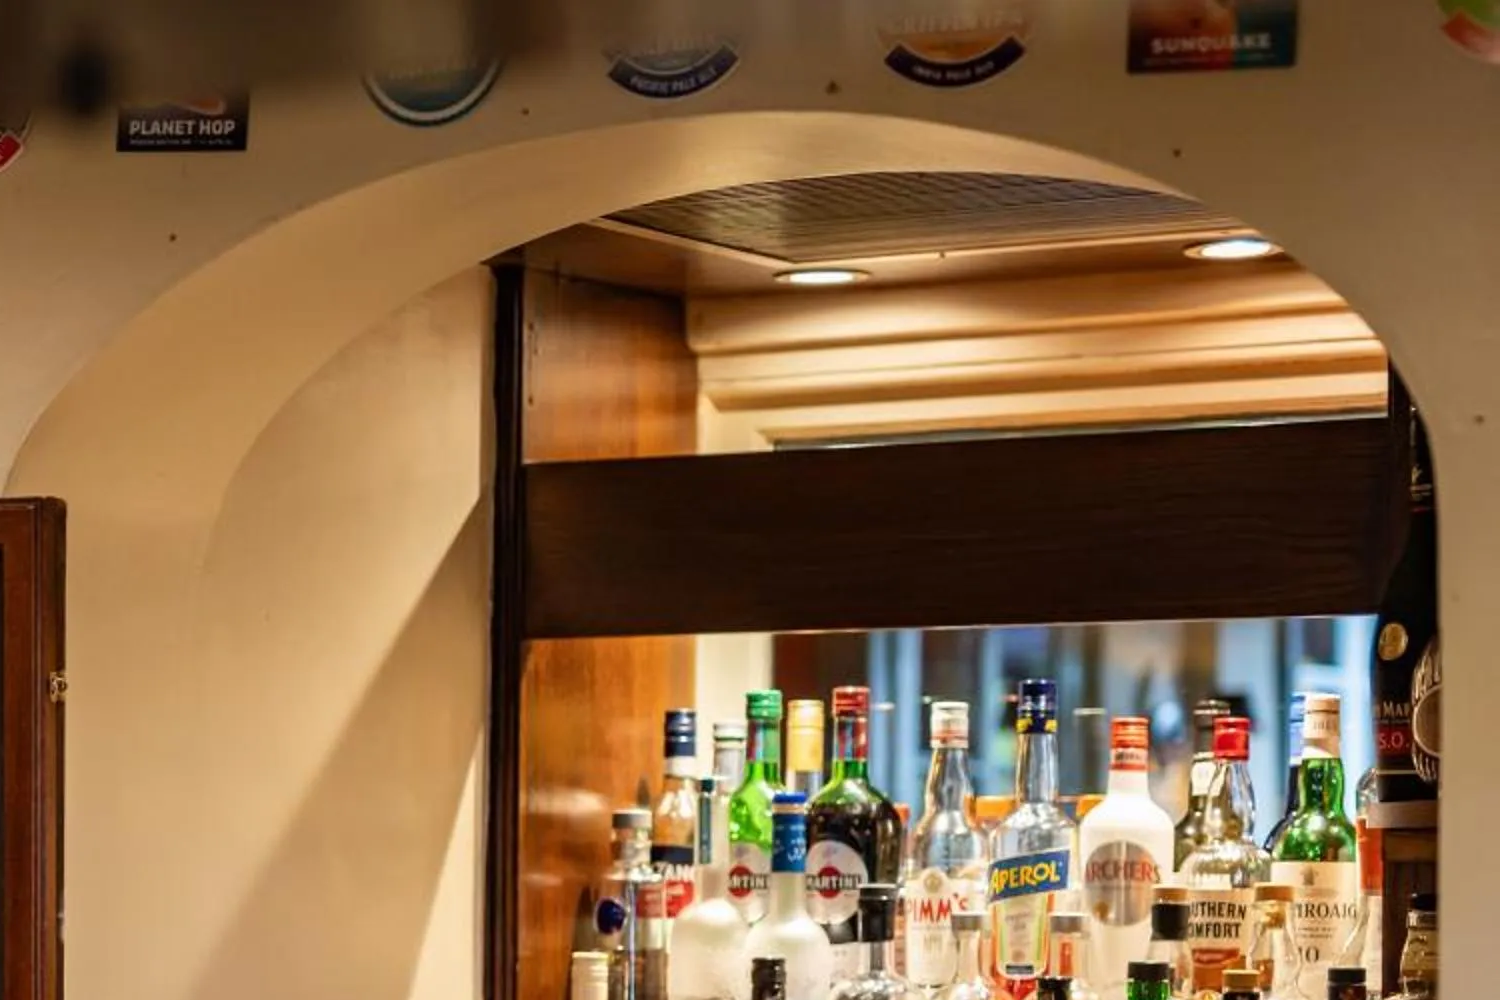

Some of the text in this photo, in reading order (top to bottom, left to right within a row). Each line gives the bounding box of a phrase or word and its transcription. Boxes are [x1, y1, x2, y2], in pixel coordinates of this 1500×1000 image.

[1152, 33, 1270, 54] SUNQUAKE
[129, 119, 235, 135] PLANET HOP
[990, 861, 1061, 892] APEROL
[1187, 901, 1247, 919] OUTHERN
[1297, 902, 1357, 920] ROAIG
[1186, 921, 1241, 938] OMFORT
